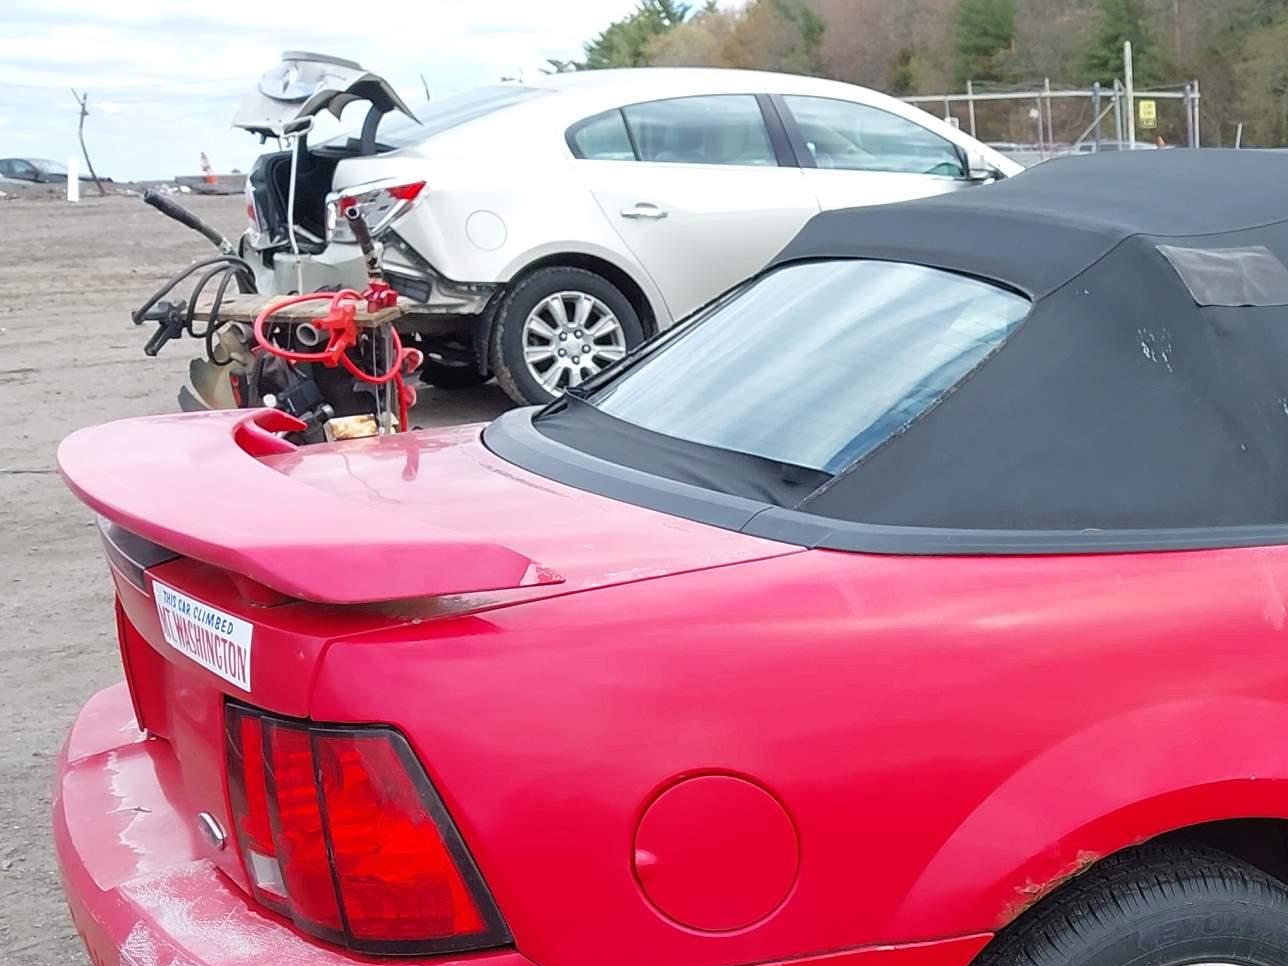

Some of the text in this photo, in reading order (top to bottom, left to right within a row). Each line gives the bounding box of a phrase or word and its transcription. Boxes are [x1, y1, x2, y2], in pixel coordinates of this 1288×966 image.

[163, 590, 234, 636] THIS CAR CLIMBED
[172, 610, 247, 684] WASHINGTON
